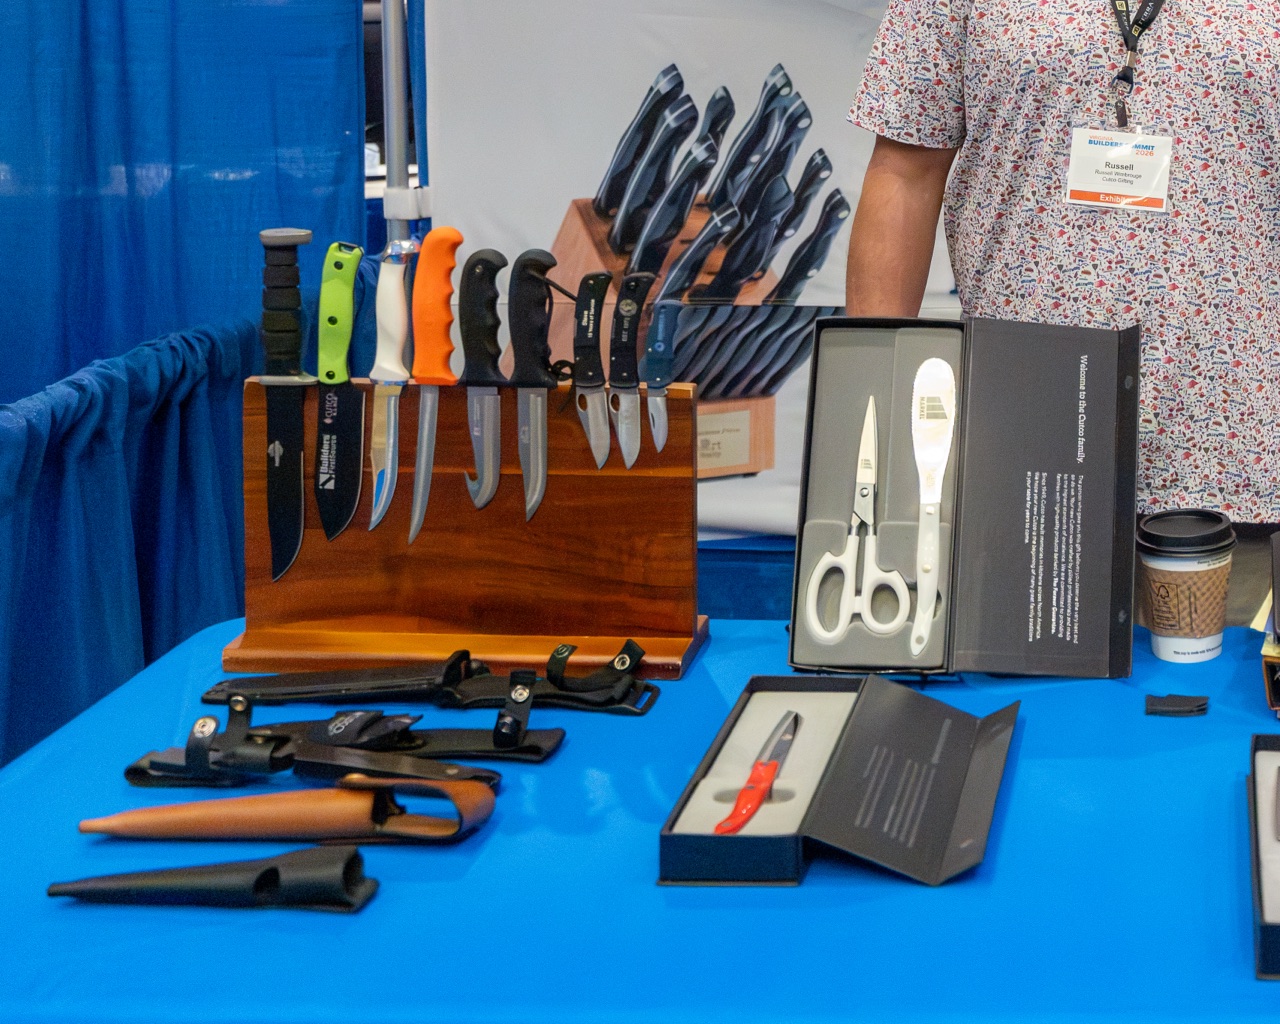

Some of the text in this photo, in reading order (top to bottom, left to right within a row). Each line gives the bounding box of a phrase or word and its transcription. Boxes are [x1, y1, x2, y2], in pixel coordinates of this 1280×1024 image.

[1135, 149, 1154, 157] 2026
[1105, 161, 1134, 171] Russell
[1076, 355, 1088, 464] Welcome to the Cutco family.
[320, 434, 330, 473] Builders
